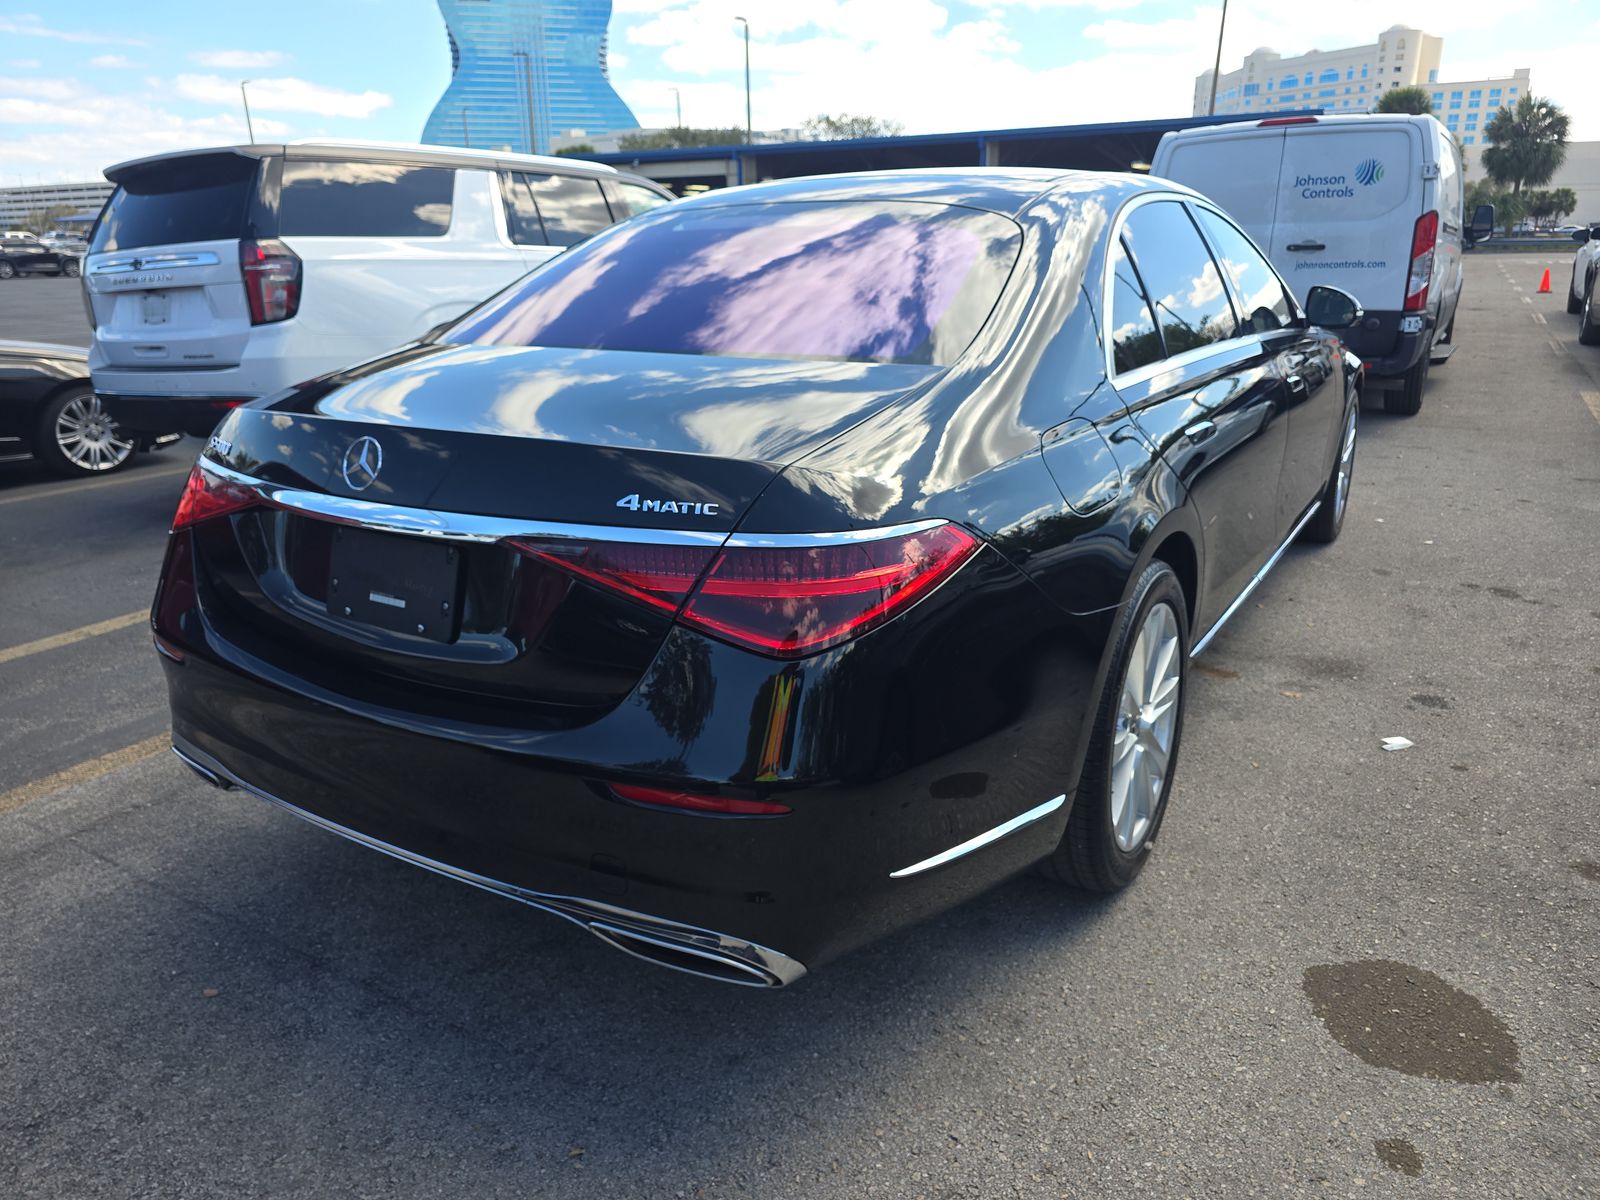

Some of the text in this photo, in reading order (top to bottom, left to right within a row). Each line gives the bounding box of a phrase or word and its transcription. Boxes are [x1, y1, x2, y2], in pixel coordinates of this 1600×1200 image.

[1294, 174, 1345, 188] Johnson
[1302, 186, 1354, 199] Controls
[616, 494, 719, 515] 4MATIC
